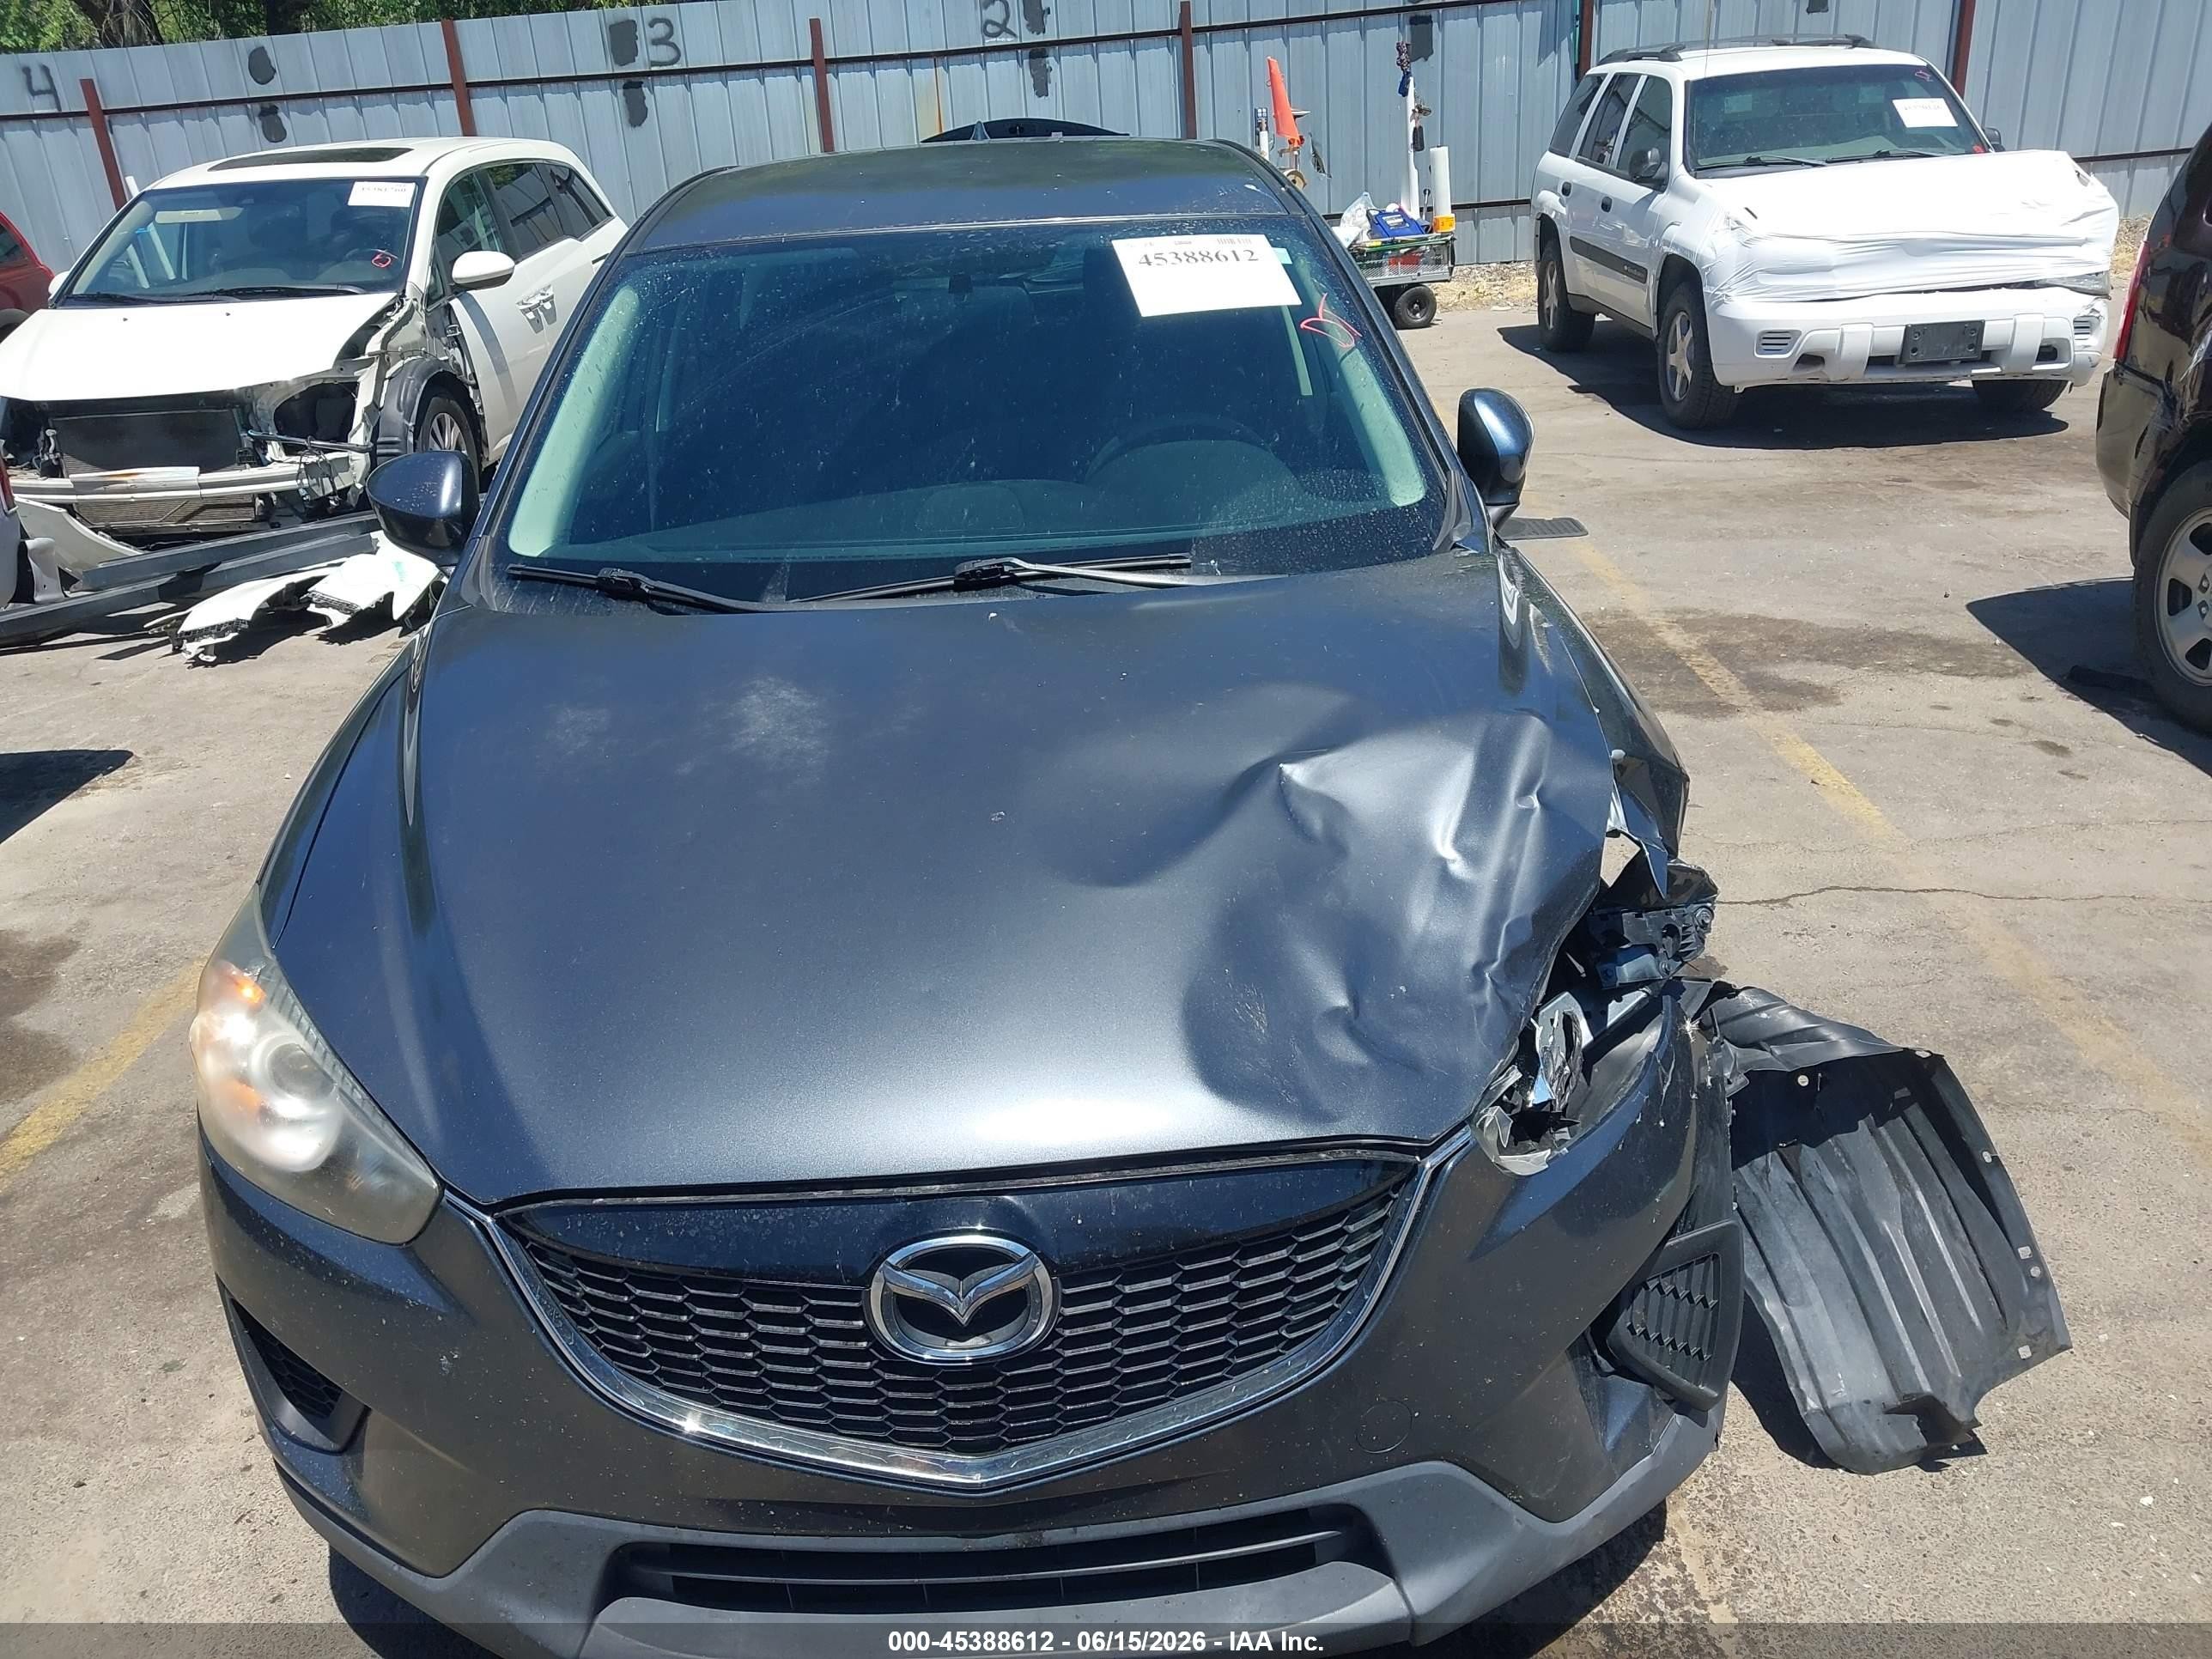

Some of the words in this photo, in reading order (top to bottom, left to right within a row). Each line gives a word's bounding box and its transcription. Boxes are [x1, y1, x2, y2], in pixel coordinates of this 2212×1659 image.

[982, 0, 1018, 39] 2
[647, 17, 683, 67] 3
[21, 63, 63, 112] 4
[1139, 249, 1260, 267] 45388612
